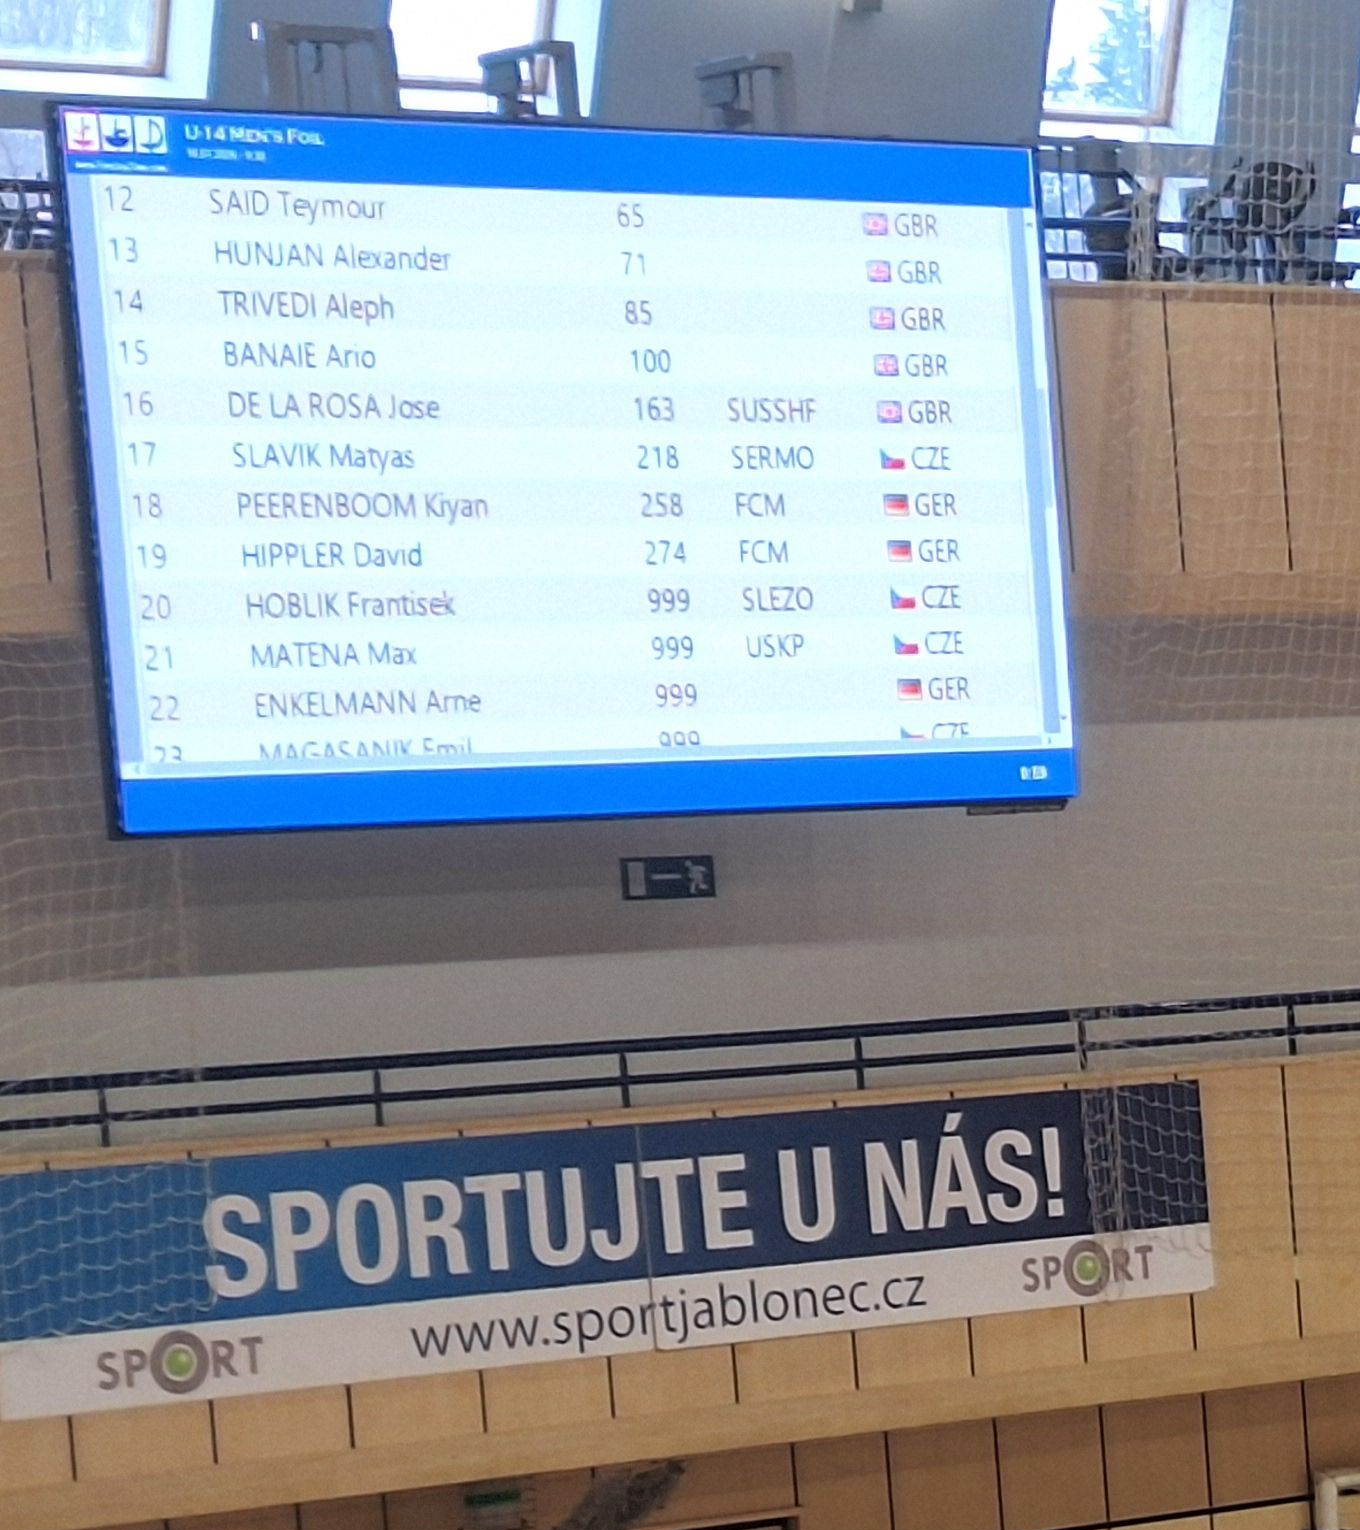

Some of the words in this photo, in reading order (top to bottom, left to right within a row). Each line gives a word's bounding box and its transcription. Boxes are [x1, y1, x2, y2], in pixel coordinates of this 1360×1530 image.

[104, 186, 134, 212] 12
[209, 188, 270, 216] SAID
[278, 190, 386, 224] Teymour
[617, 203, 645, 229] 65
[895, 213, 938, 236] GBR
[109, 237, 138, 263] 13
[214, 240, 323, 269] HUNJAN
[333, 244, 450, 272] Alexander
[620, 251, 646, 276] 71
[898, 260, 942, 284] GBR
[114, 290, 143, 314] 14
[218, 290, 317, 319] TRIVEDI
[326, 292, 394, 327] Aleph
[624, 300, 652, 326] 85
[901, 307, 946, 331] GBR
[119, 340, 148, 365] 15
[223, 341, 317, 369] BANAIE
[326, 343, 376, 370] Ario
[630, 349, 671, 374] 100
[905, 354, 948, 377] GBR
[124, 391, 154, 417] 16
[228, 391, 261, 419] DE
[269, 391, 302, 419] LA
[309, 392, 381, 420] ROSA
[388, 394, 440, 420] Jose
[634, 397, 675, 422] 163
[727, 398, 817, 424] SUSSHF
[908, 401, 952, 424] GBR
[128, 441, 156, 466] 17
[232, 442, 321, 469] SLAVIK
[329, 443, 416, 475] Matyas
[637, 446, 679, 471] 218
[732, 445, 815, 471] SERMO
[911, 447, 952, 470] CZE
[133, 493, 163, 519] 18
[237, 492, 417, 520] PEERENBOOM
[425, 493, 489, 527] Kiyan
[641, 492, 684, 517] 258
[736, 493, 786, 518] FCM
[915, 493, 957, 517] GER
[137, 543, 168, 569] 19
[242, 543, 345, 569] HIPPLER
[355, 541, 424, 568] David
[645, 540, 687, 565] 274
[739, 540, 789, 564] FCM
[918, 539, 961, 563] GER
[141, 594, 171, 620] 20
[246, 593, 340, 619] HOBLIK
[347, 590, 456, 617] Frantisek
[647, 588, 691, 613] 999
[742, 586, 814, 612] SLEZO
[921, 584, 962, 609] CZE
[145, 645, 174, 671] 21
[251, 641, 361, 668] MATENA
[368, 640, 418, 666] Max
[651, 635, 694, 661] 999
[747, 633, 805, 659] USKP
[924, 630, 965, 655] CZE
[150, 695, 180, 721] 22
[255, 690, 417, 718] ENKELMANN
[425, 690, 483, 714] Arne
[655, 682, 699, 707] 999
[928, 676, 971, 701] GER
[203, 1152, 755, 1298] SPORTUJTE
[777, 1145, 837, 1244] U
[864, 1111, 1066, 1235] NÁS!
[1022, 1239, 1153, 1297] SPORT
[410, 1273, 927, 1359] www.sportjablonec.cz
[96, 1329, 263, 1394] SPORT
